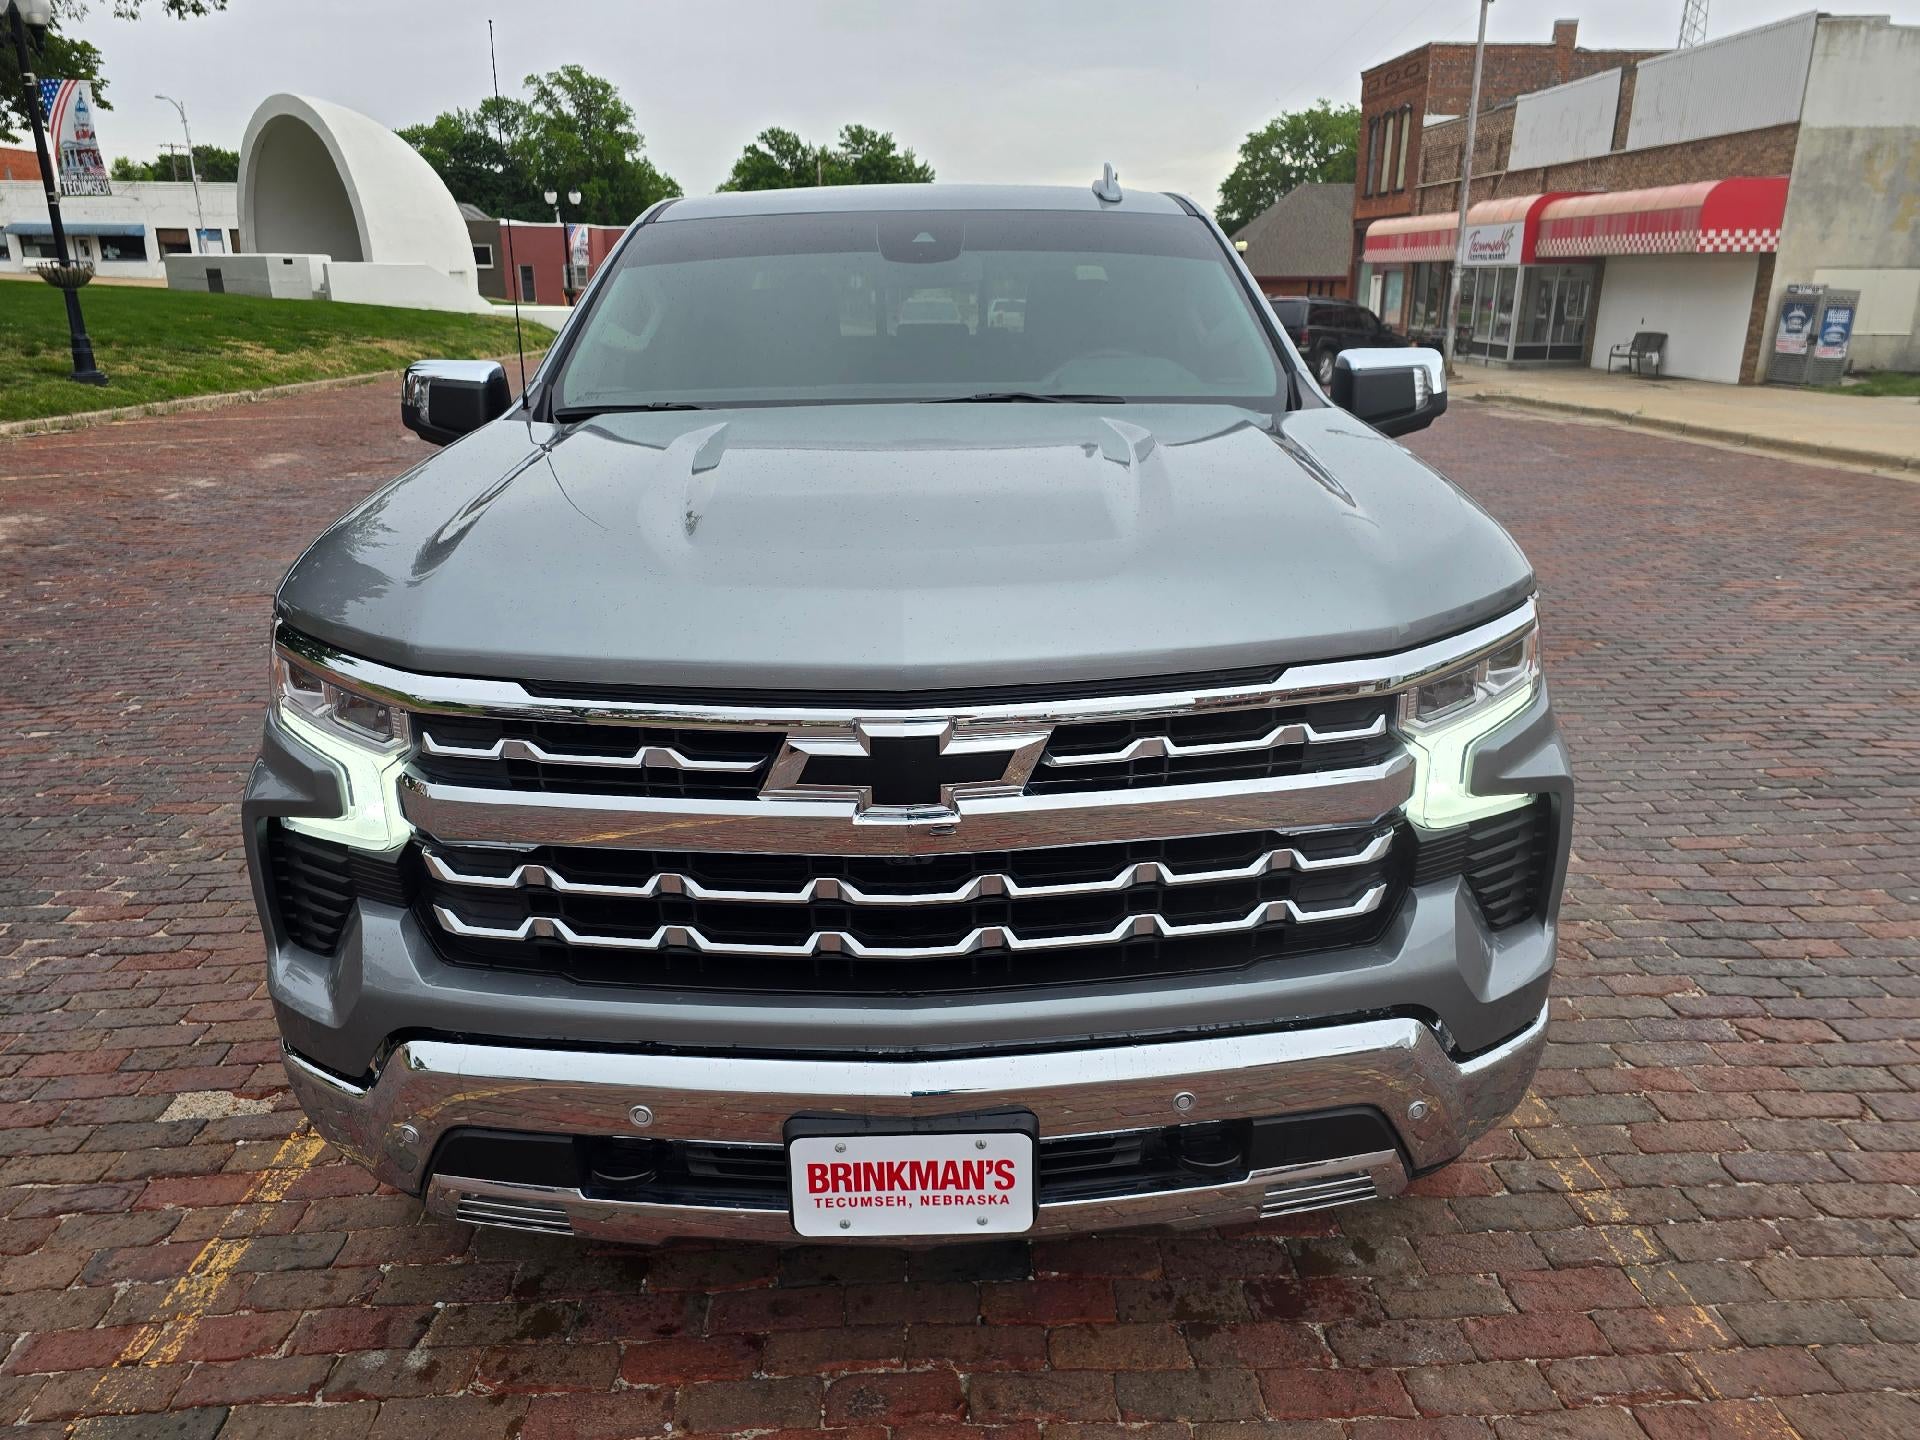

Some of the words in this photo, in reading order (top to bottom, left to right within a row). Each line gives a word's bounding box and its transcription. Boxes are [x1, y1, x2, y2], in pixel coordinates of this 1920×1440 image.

[61, 180, 111, 195] TECUMSEH
[807, 1159, 1016, 1194] BRINKMAN'S
[814, 1195, 913, 1209] TECUMSEH,
[920, 1194, 1010, 1206] NEBRASKA
